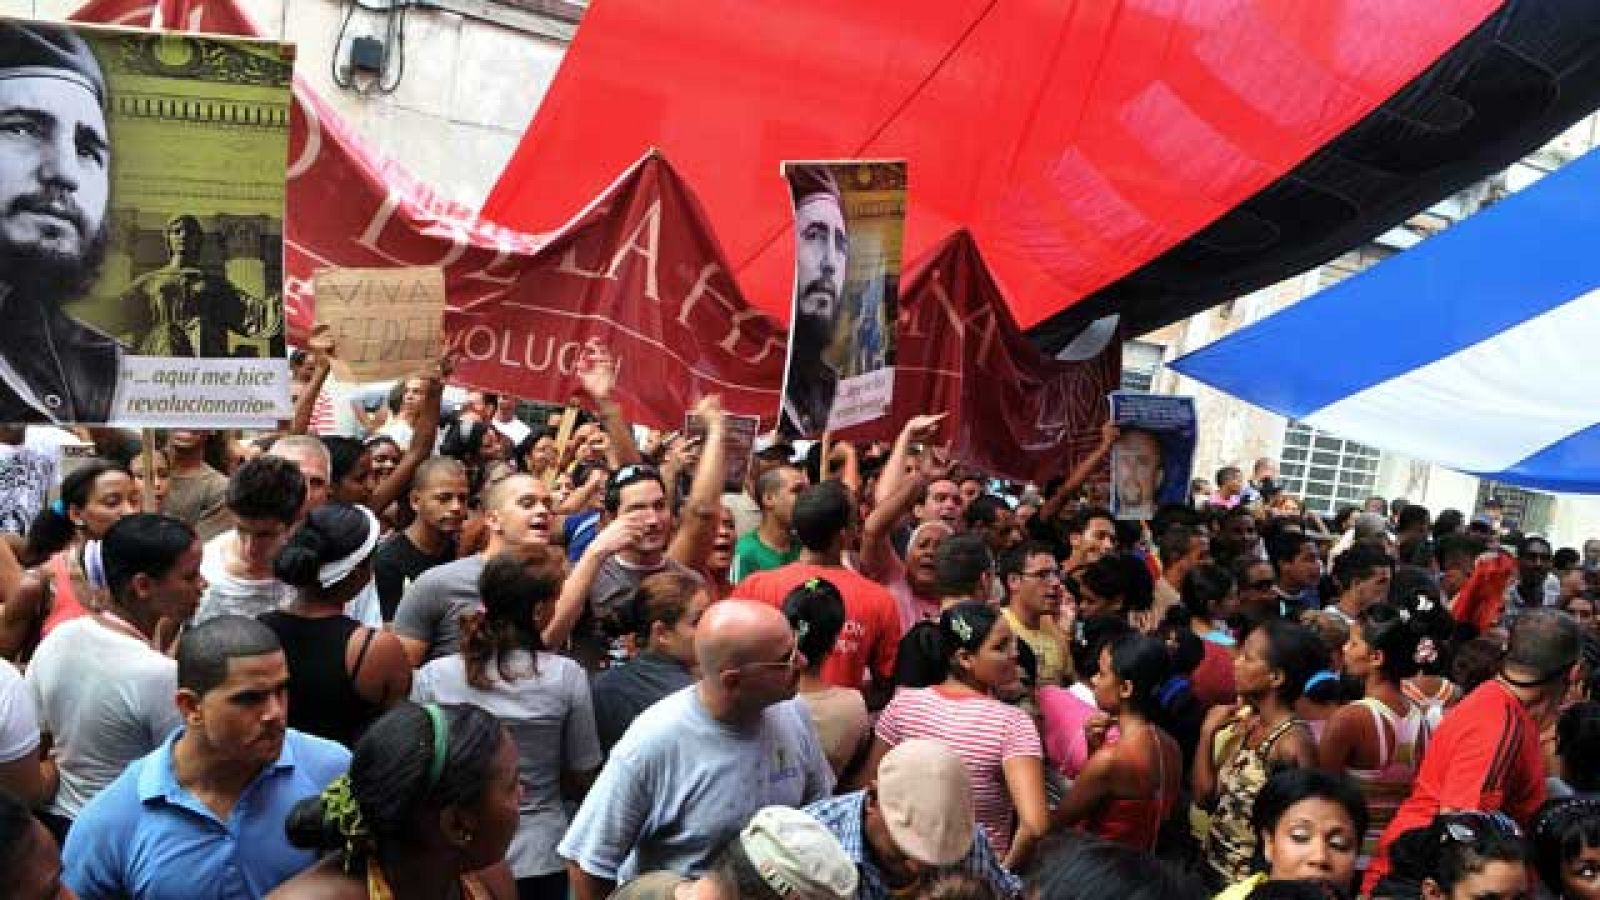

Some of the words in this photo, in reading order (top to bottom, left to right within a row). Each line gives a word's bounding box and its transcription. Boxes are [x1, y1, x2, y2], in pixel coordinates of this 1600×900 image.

[331, 279, 430, 304] VIVA
[152, 367, 197, 388] aquí
[202, 371, 231, 386] me
[236, 366, 275, 386] hice
